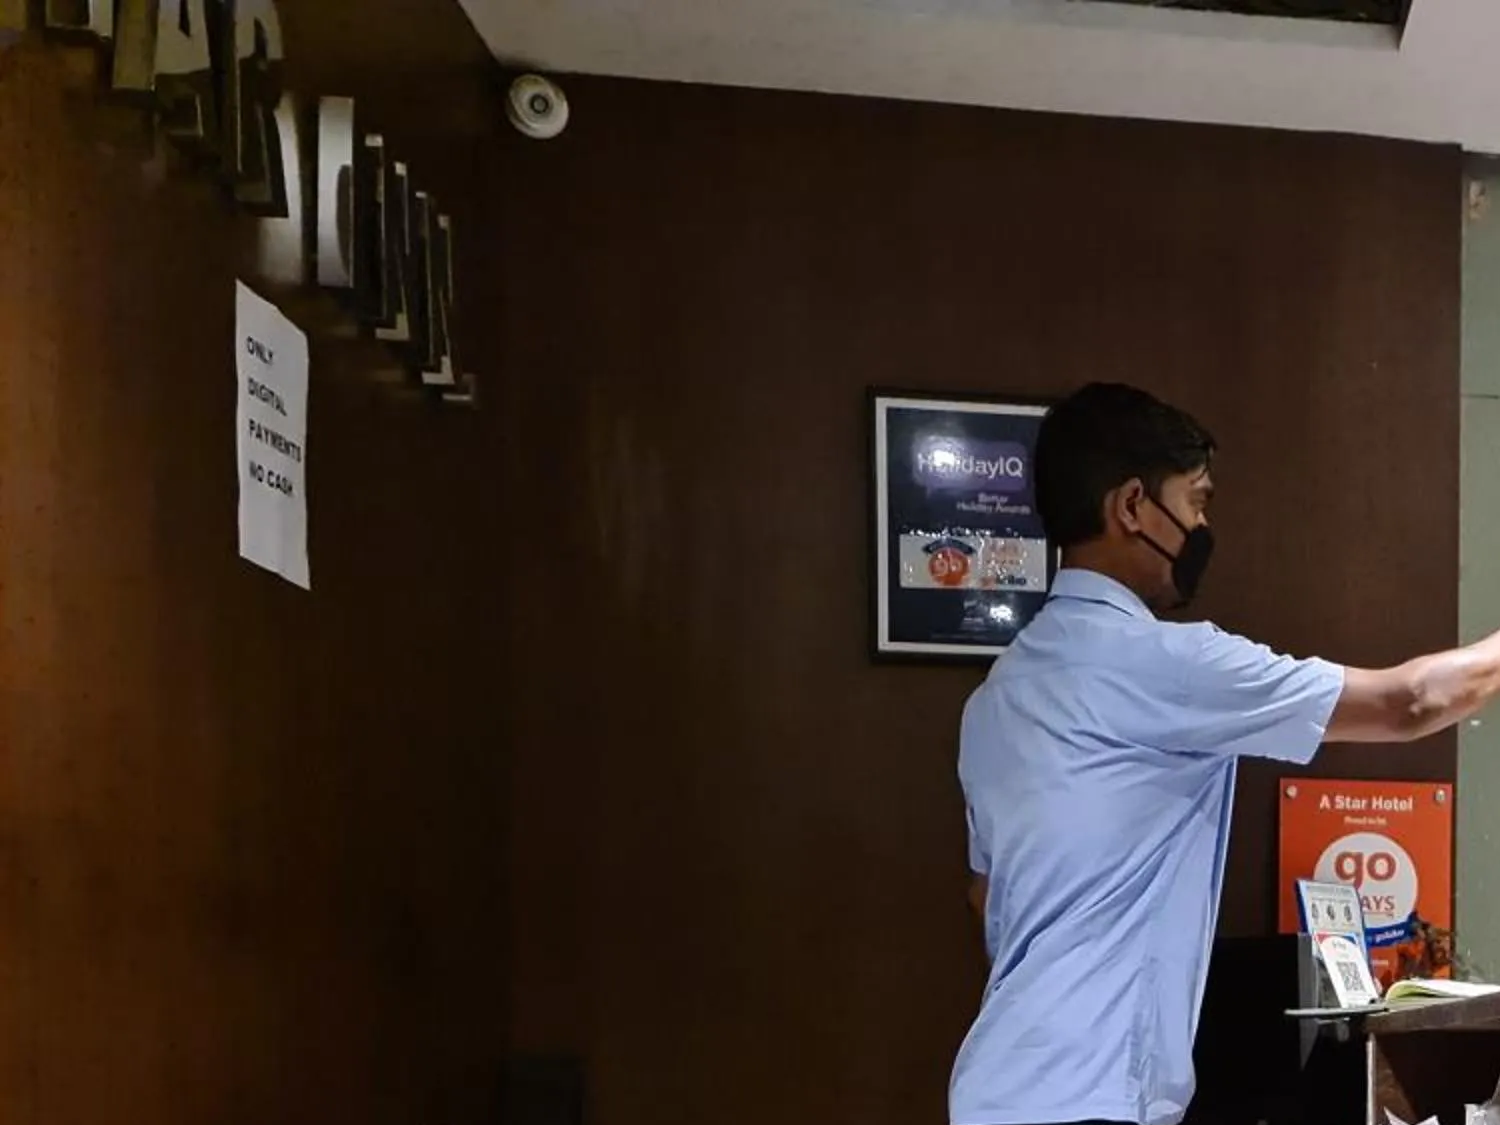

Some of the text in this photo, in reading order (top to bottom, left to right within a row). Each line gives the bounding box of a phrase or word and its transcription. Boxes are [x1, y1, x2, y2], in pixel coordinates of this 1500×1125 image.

[246, 335, 274, 365] ONLY
[248, 377, 287, 417] DIGITAL
[249, 418, 302, 463] PAYMENTS
[249, 460, 294, 496] NO CASH
[1319, 794, 1413, 811] A Star Hotel
[1334, 850, 1397, 890] go
[1361, 895, 1395, 911] AYS
